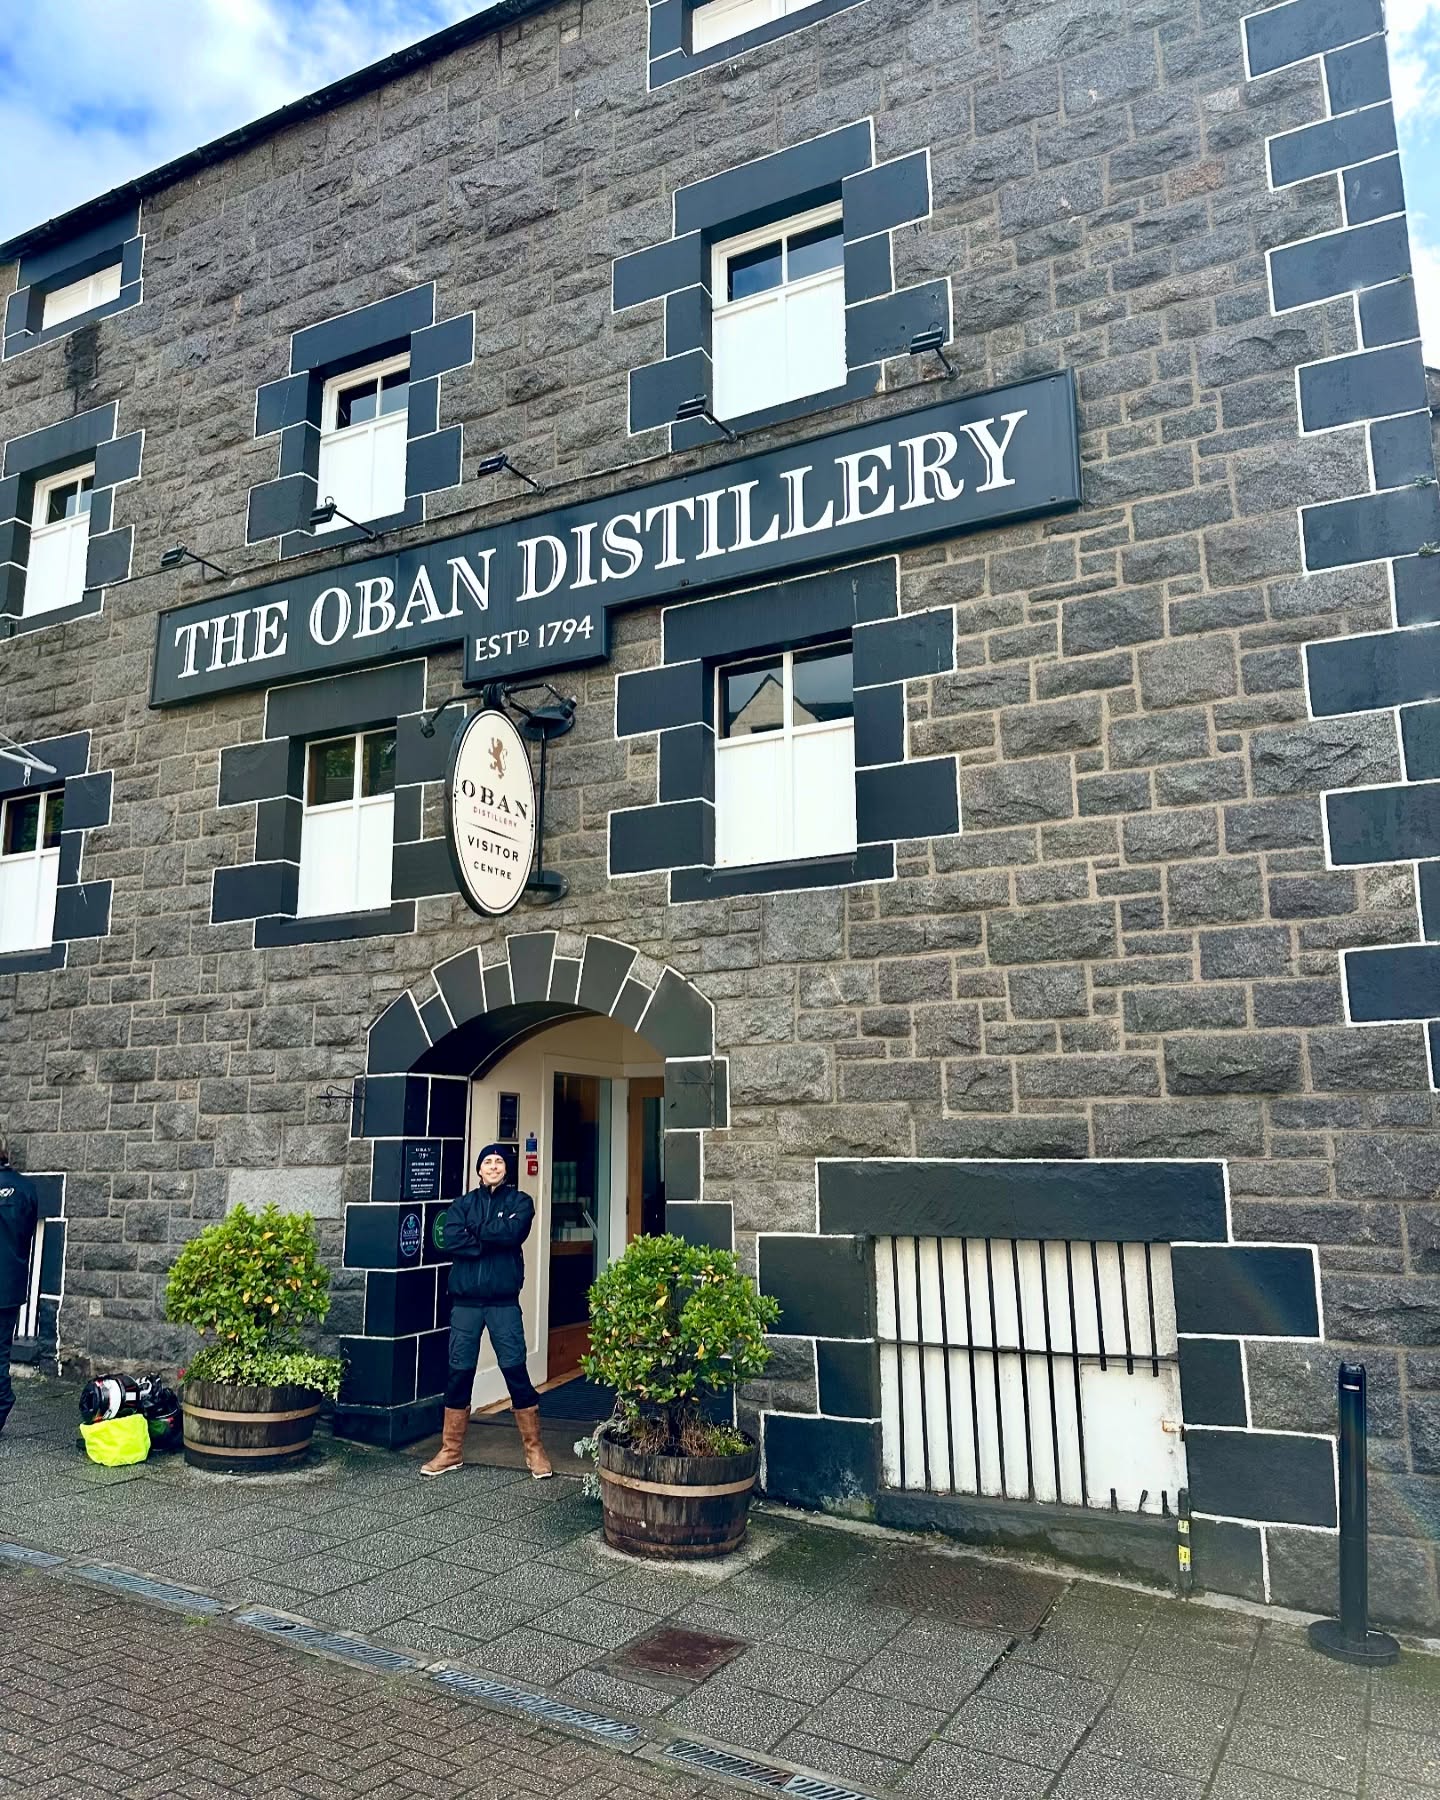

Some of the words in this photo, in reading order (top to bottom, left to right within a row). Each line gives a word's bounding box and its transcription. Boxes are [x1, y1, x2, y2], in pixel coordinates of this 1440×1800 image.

[174, 599, 289, 679] THE
[308, 547, 497, 646] OBAN
[515, 409, 1029, 602] DISTILLERY
[538, 614, 594, 649] 1794
[461, 779, 528, 820] OBAN
[473, 805, 518, 828] DISTILLERY
[467, 834, 520, 862] VISITOR
[473, 860, 512, 880] CENTRE
